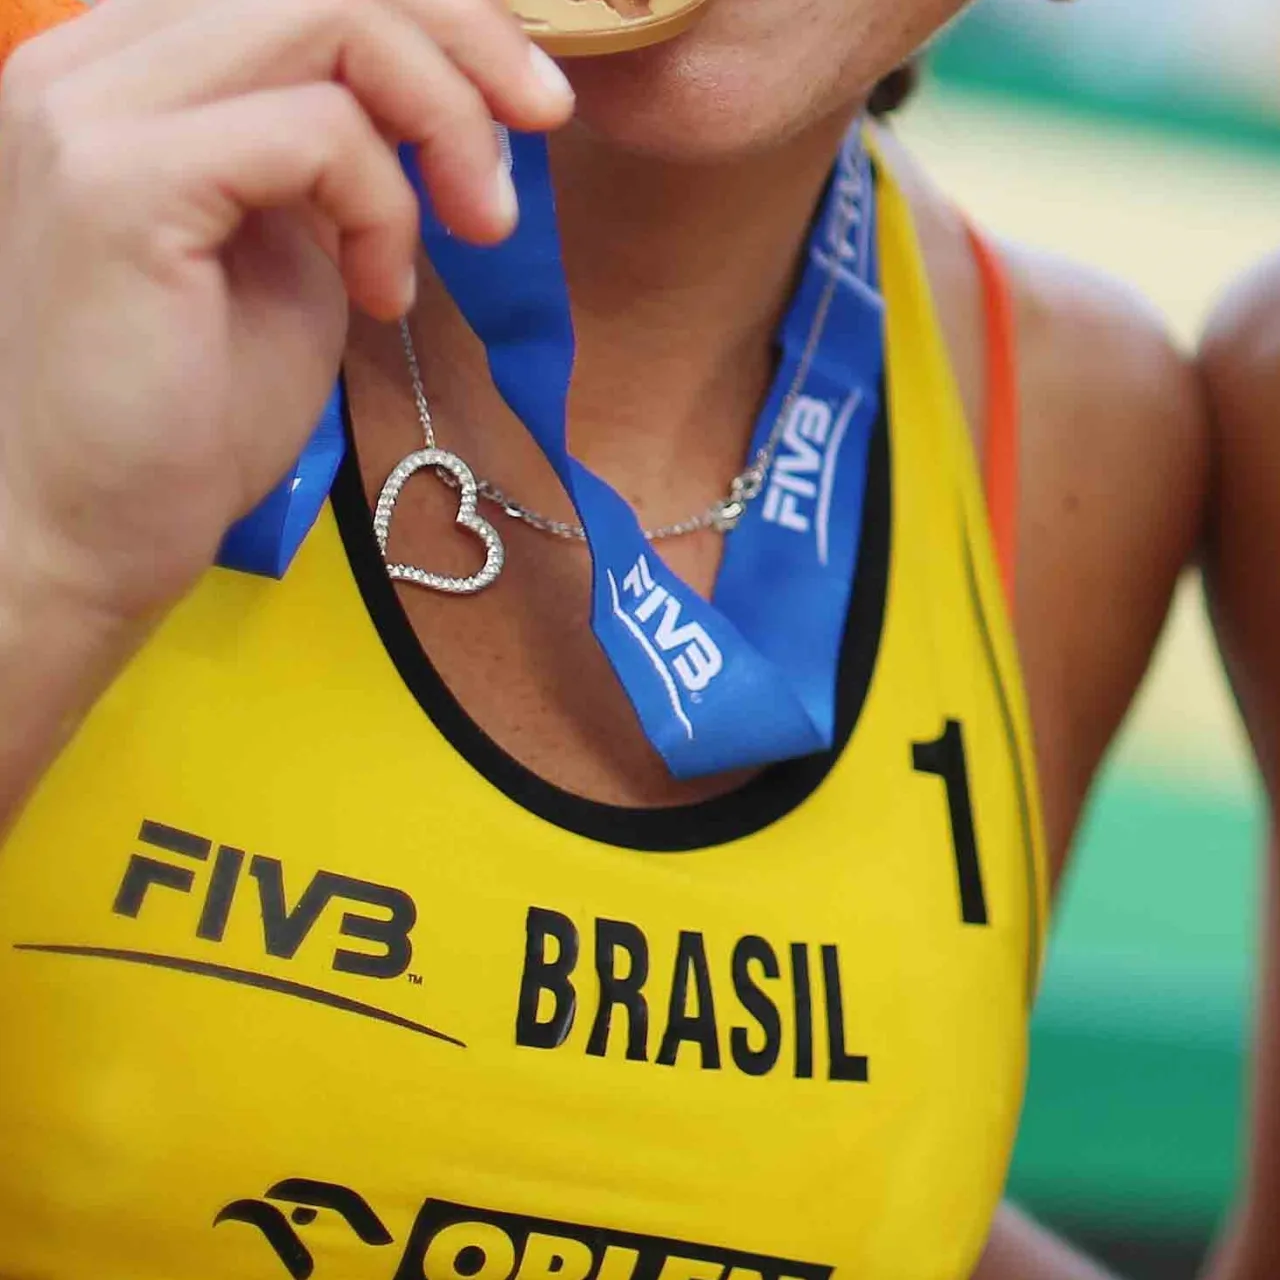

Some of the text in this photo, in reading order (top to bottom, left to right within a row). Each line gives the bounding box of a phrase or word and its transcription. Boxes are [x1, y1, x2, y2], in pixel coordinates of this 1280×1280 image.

[761, 394, 833, 533] FIVB
[622, 553, 724, 692] FIVB
[111, 817, 418, 981] FIVB
[911, 719, 988, 925] 1
[514, 904, 871, 1083] BRASIL
